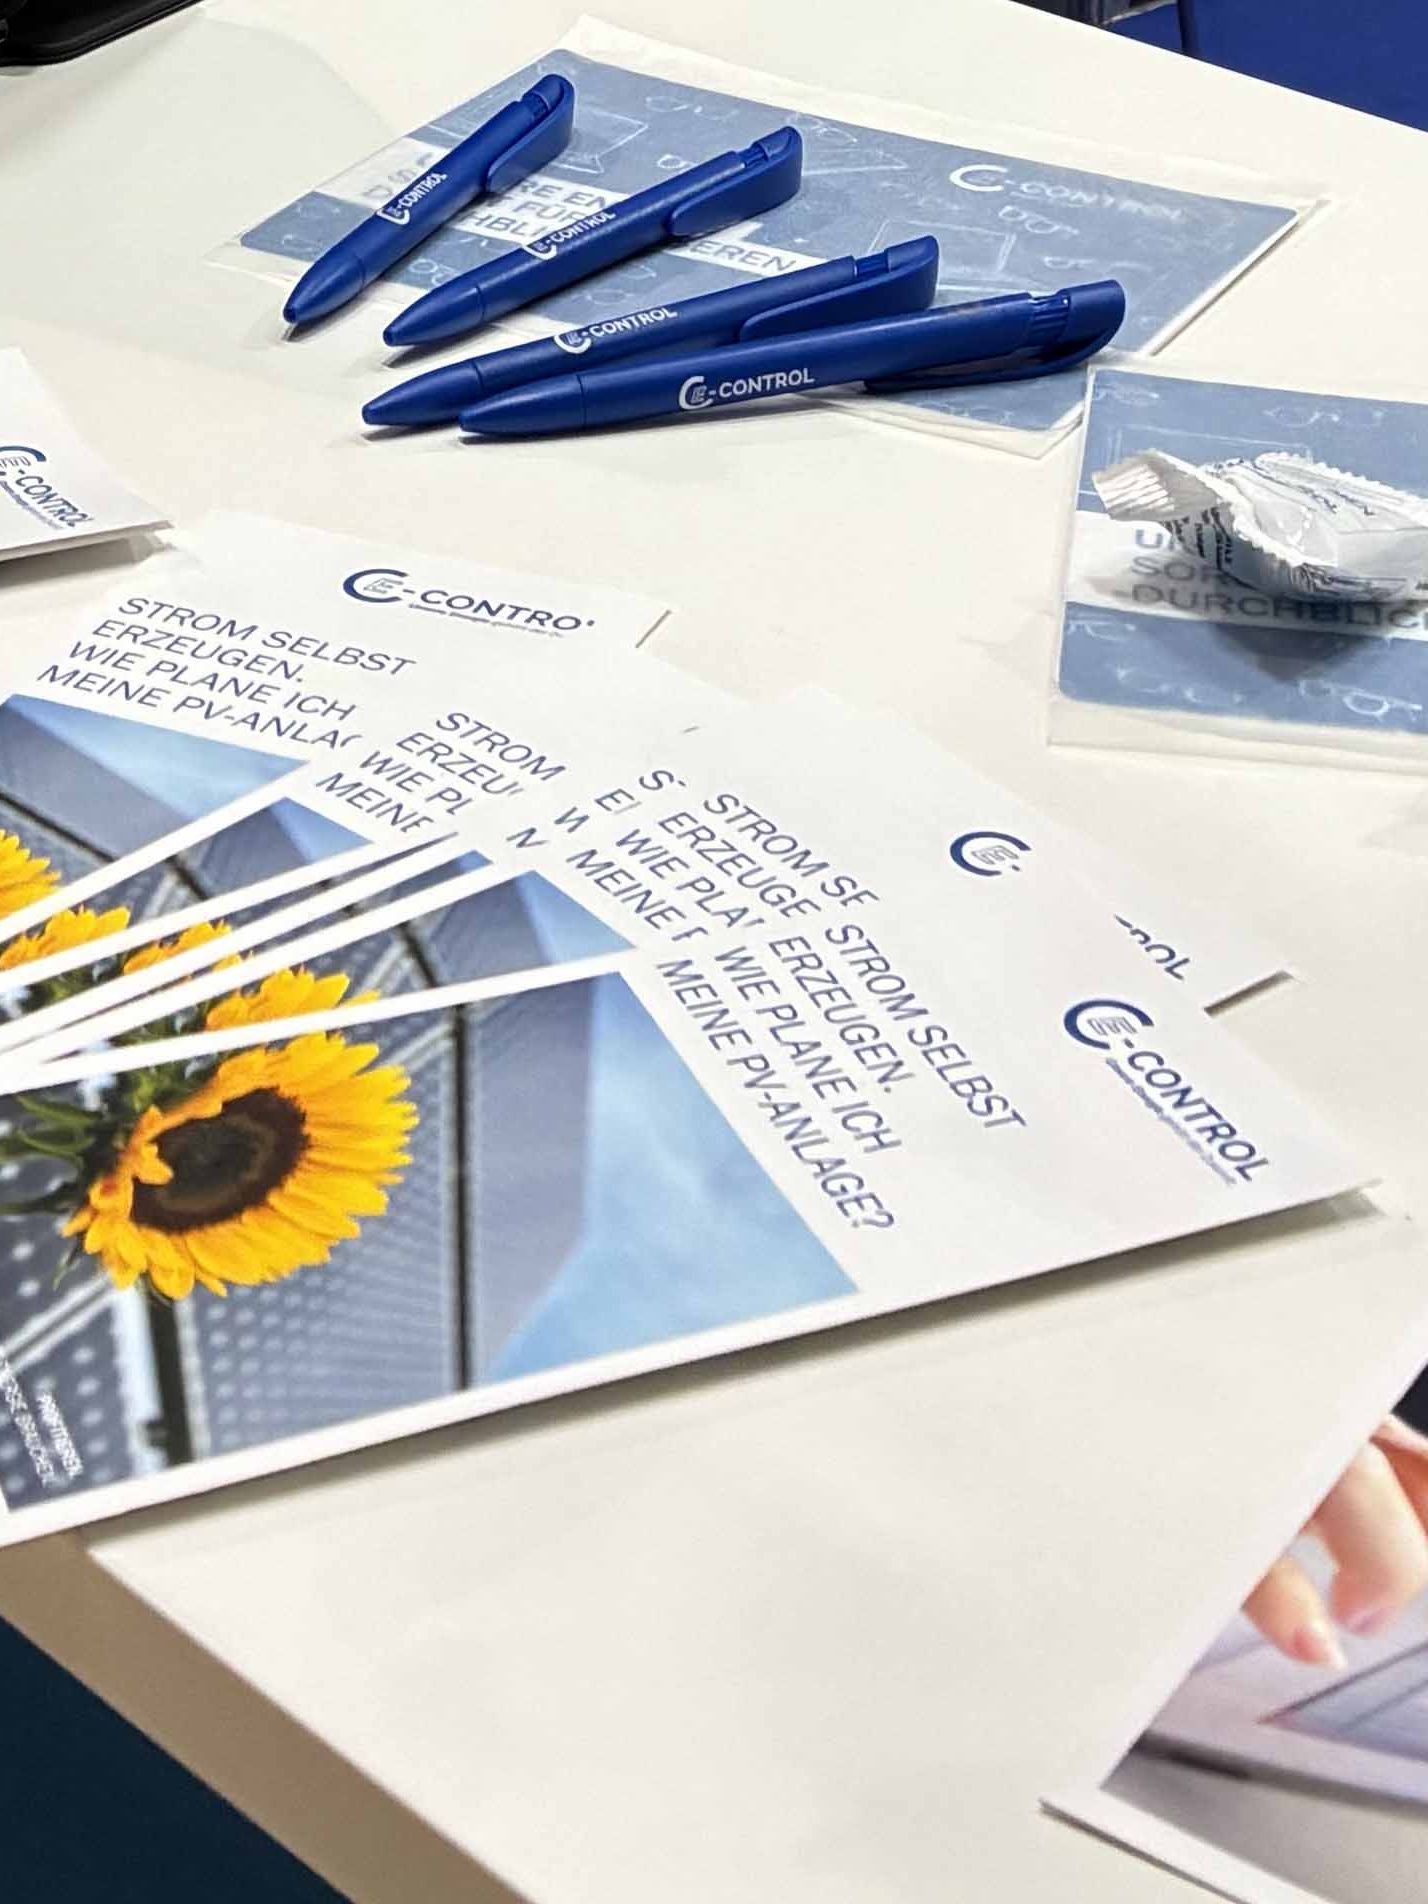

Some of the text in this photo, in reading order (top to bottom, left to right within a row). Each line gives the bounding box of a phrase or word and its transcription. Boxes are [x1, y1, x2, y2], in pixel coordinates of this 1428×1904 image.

[679, 368, 815, 411] E-CONTROL
[117, 597, 418, 677] STROM SELBST
[342, 568, 596, 632] E-CONTRO
[69, 640, 357, 721] WIE PLANE ICH
[91, 619, 305, 683] ERZEUGEN.
[36, 664, 363, 748] MEINE PV-ANLA
[435, 711, 567, 782] STROM
[359, 750, 436, 793] WIE
[615, 828, 691, 881] WIE
[657, 810, 822, 919] ERZEUGE
[703, 792, 831, 879] STROM
[566, 848, 687, 931] MEINE
[714, 945, 902, 1154] WIE PLANE ICH
[768, 935, 917, 1093] ERZEUGEN.
[825, 922, 1027, 1130] STROM SELBST
[656, 958, 896, 1229] MEINE PV-ANLAGE?
[1062, 998, 1275, 1187] E-CONTROL
